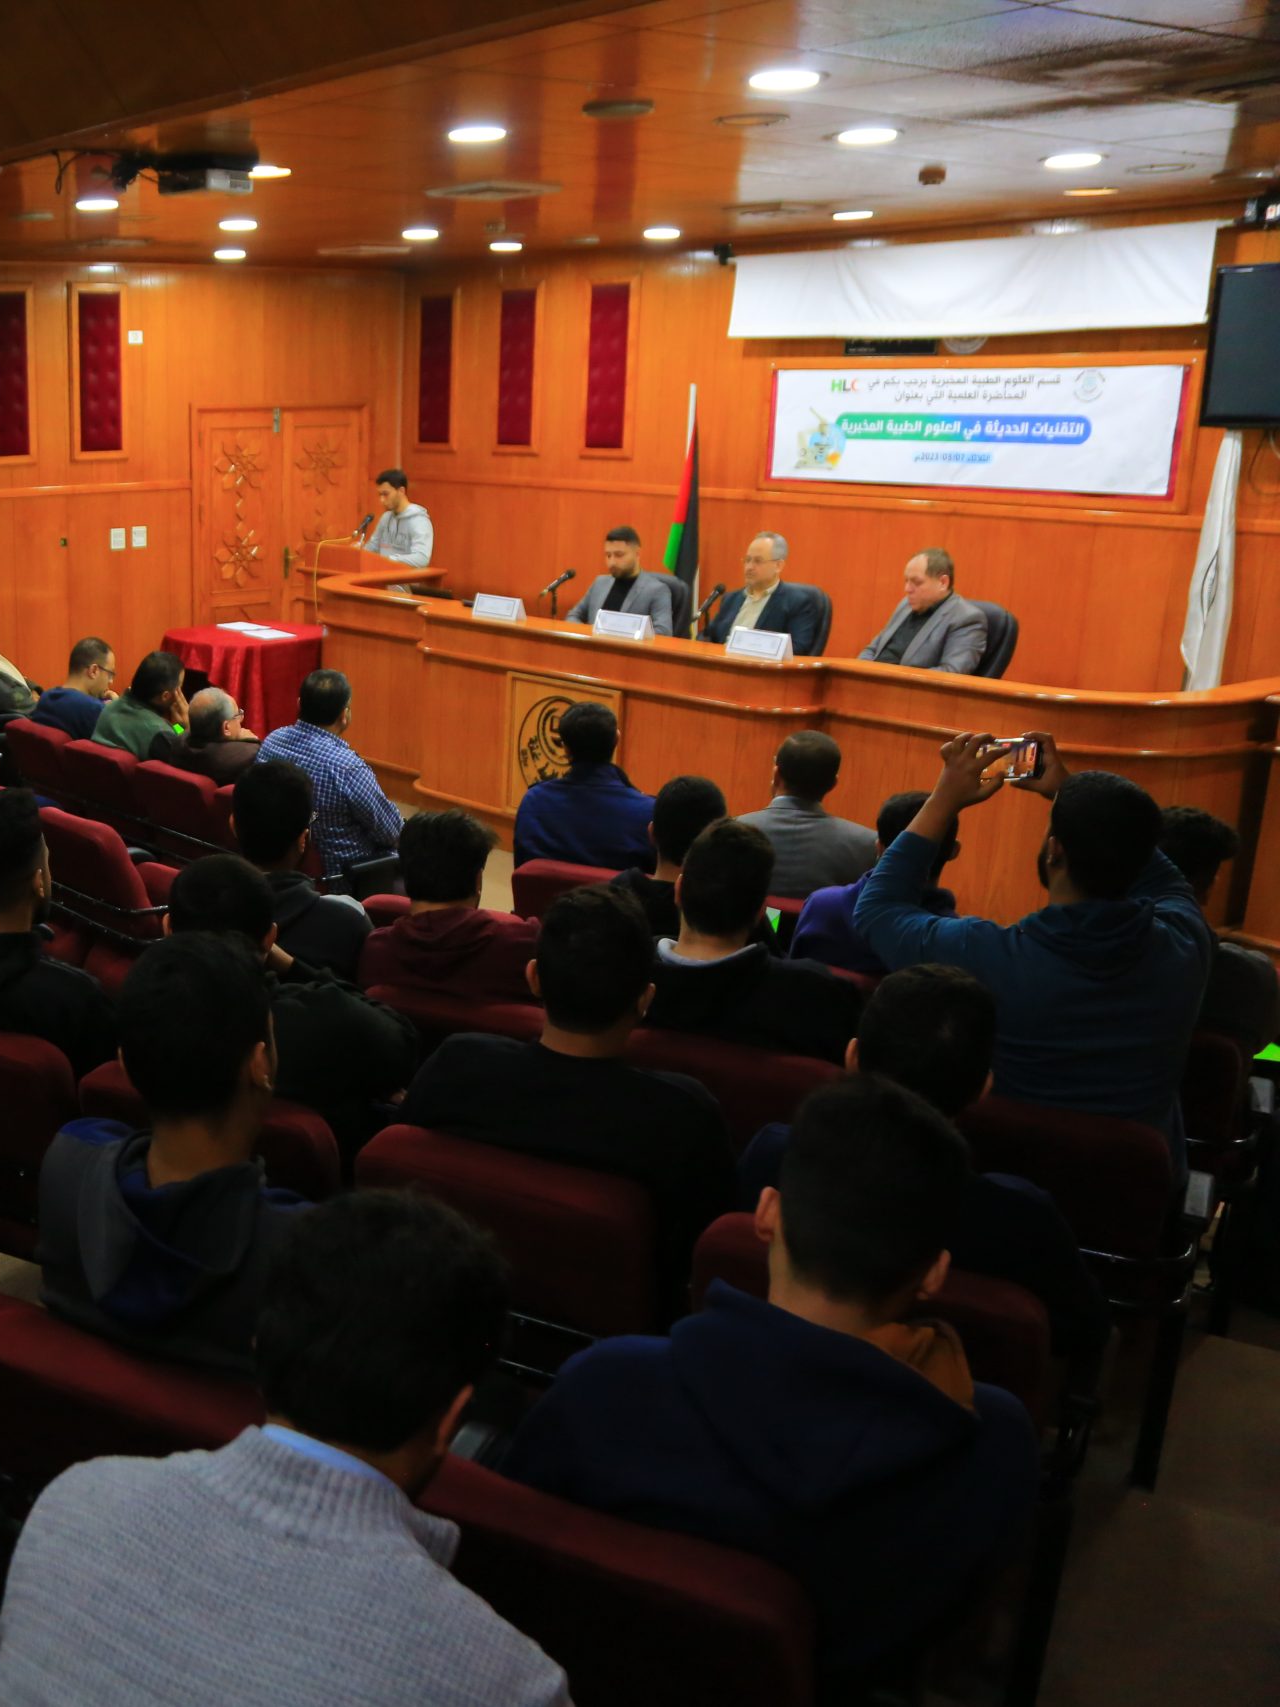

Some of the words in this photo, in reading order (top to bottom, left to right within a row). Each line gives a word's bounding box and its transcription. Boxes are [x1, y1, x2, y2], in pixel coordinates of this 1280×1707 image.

[931, 375, 969, 388] المخبرية
[971, 375, 1001, 387] الطبية
[1004, 375, 1034, 388] العلوم
[948, 390, 979, 402] العلمية
[841, 418, 883, 435] المخبرية
[886, 419, 922, 435] الطبية
[924, 420, 962, 438] العلوم
[963, 420, 982, 440] في
[984, 419, 1029, 438] الحديثة
[1031, 421, 1085, 439] التقنيات
